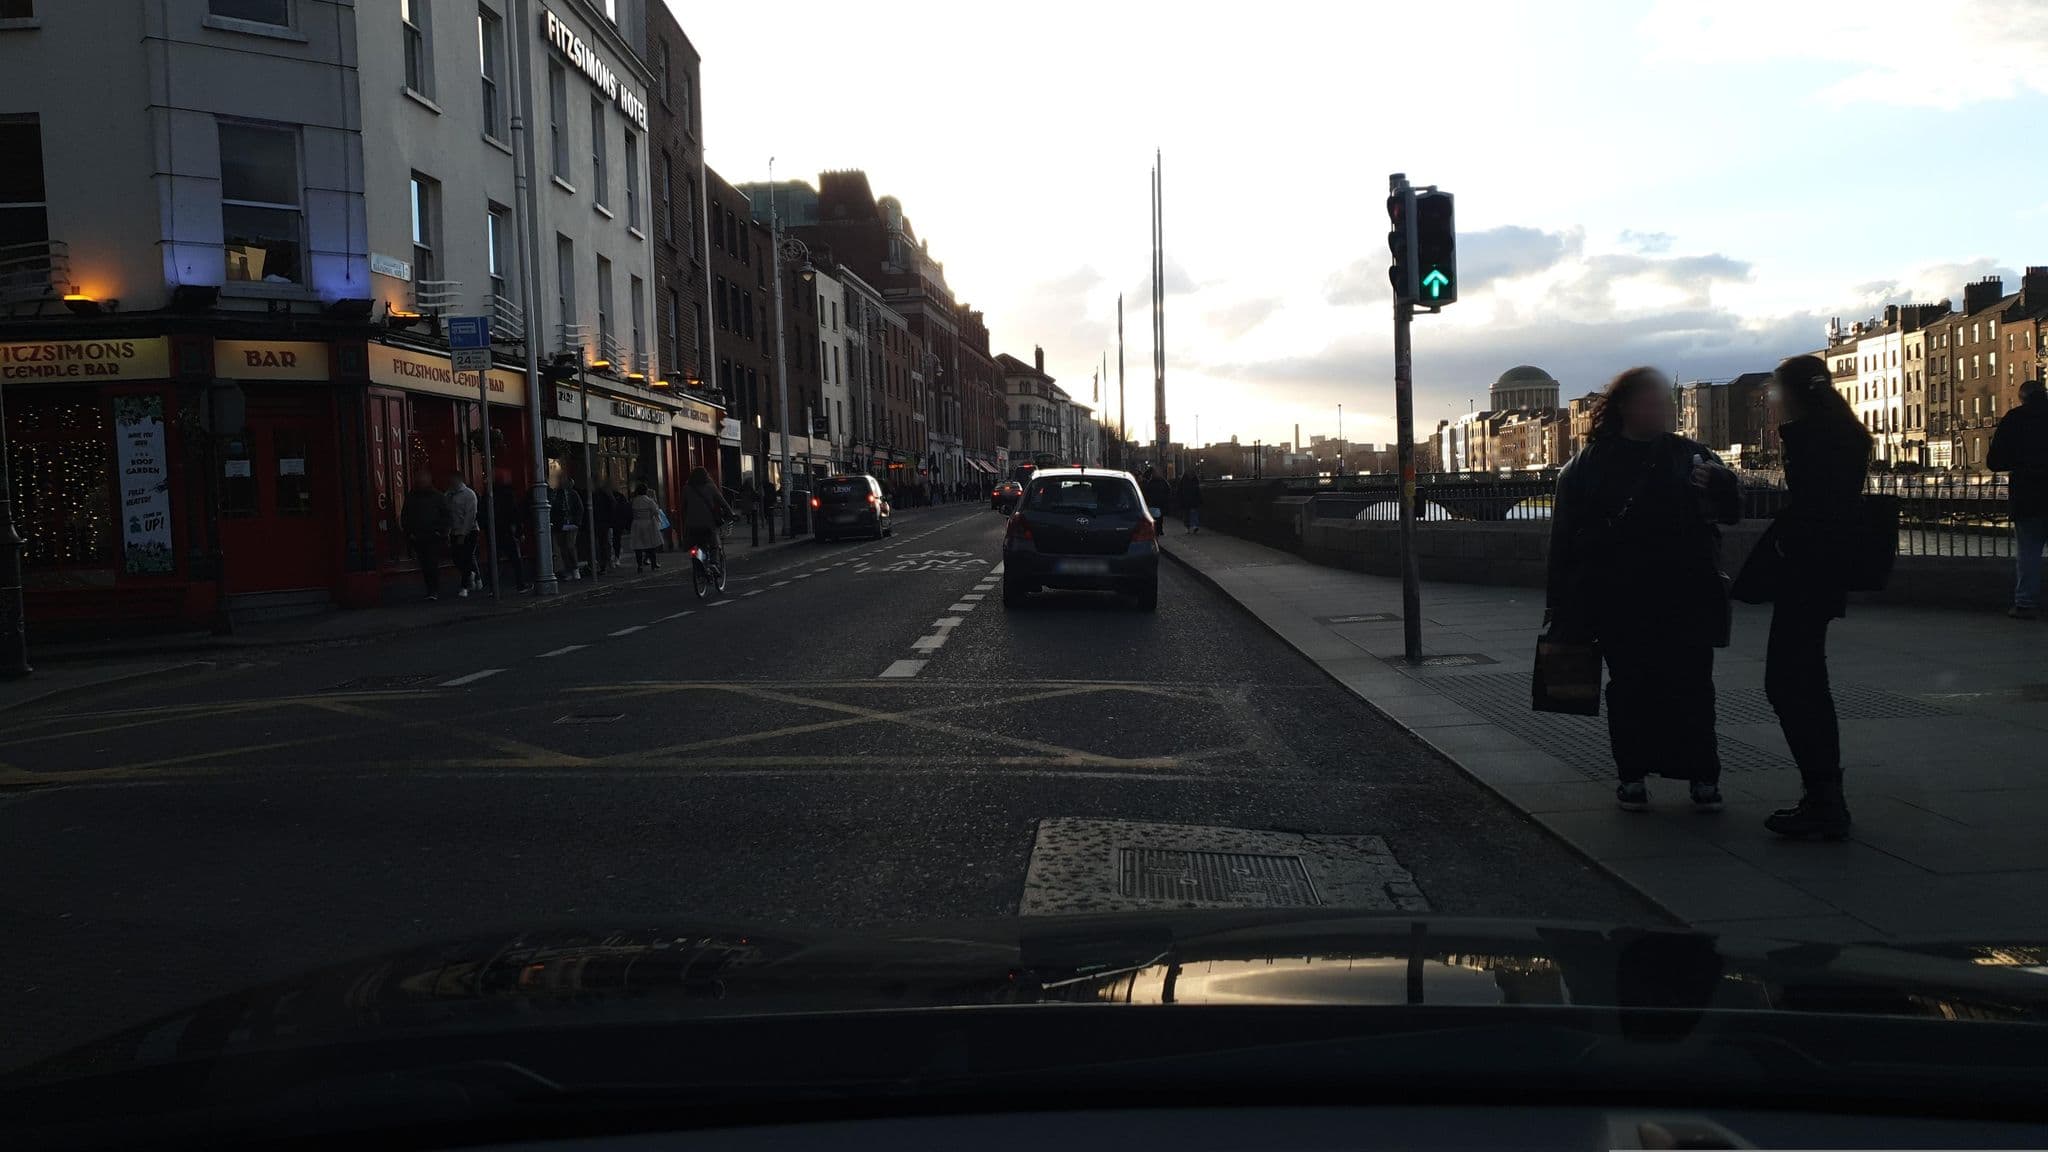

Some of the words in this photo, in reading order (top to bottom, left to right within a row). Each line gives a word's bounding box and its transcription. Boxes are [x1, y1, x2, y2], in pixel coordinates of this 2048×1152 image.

[545, 9, 617, 101] FITZSIMONS
[620, 84, 648, 132] HOTEL
[0, 342, 134, 363] ITZSIMONS
[244, 350, 297, 368] BAR
[3, 364, 79, 378] TEMPLE
[84, 363, 120, 376] BAR
[393, 359, 451, 383] FITZSIMONS
[488, 377, 504, 392] BAR
[145, 516, 164, 531] UP!
